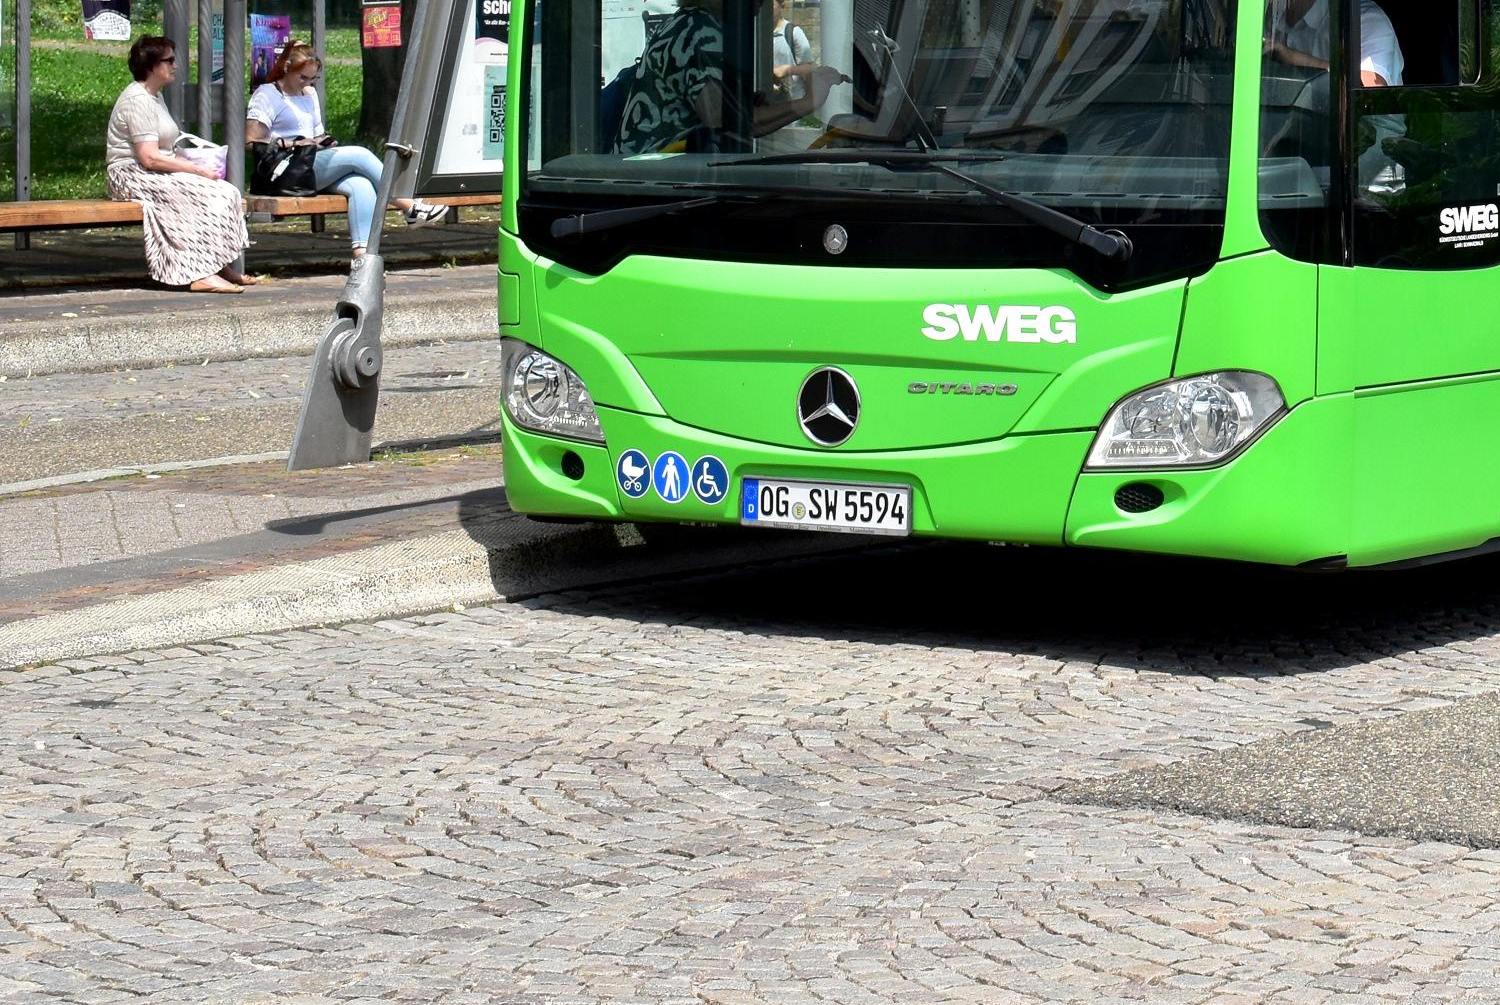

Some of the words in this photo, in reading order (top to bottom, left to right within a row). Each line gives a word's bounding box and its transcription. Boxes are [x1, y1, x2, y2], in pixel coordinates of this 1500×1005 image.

[1438, 203, 1499, 235] SWEG
[921, 303, 1076, 344] SWEG
[907, 380, 1018, 397] CITARO
[748, 503, 754, 514] D
[760, 486, 789, 517] OG
[809, 489, 838, 521] SW
[844, 491, 905, 524] 5594
